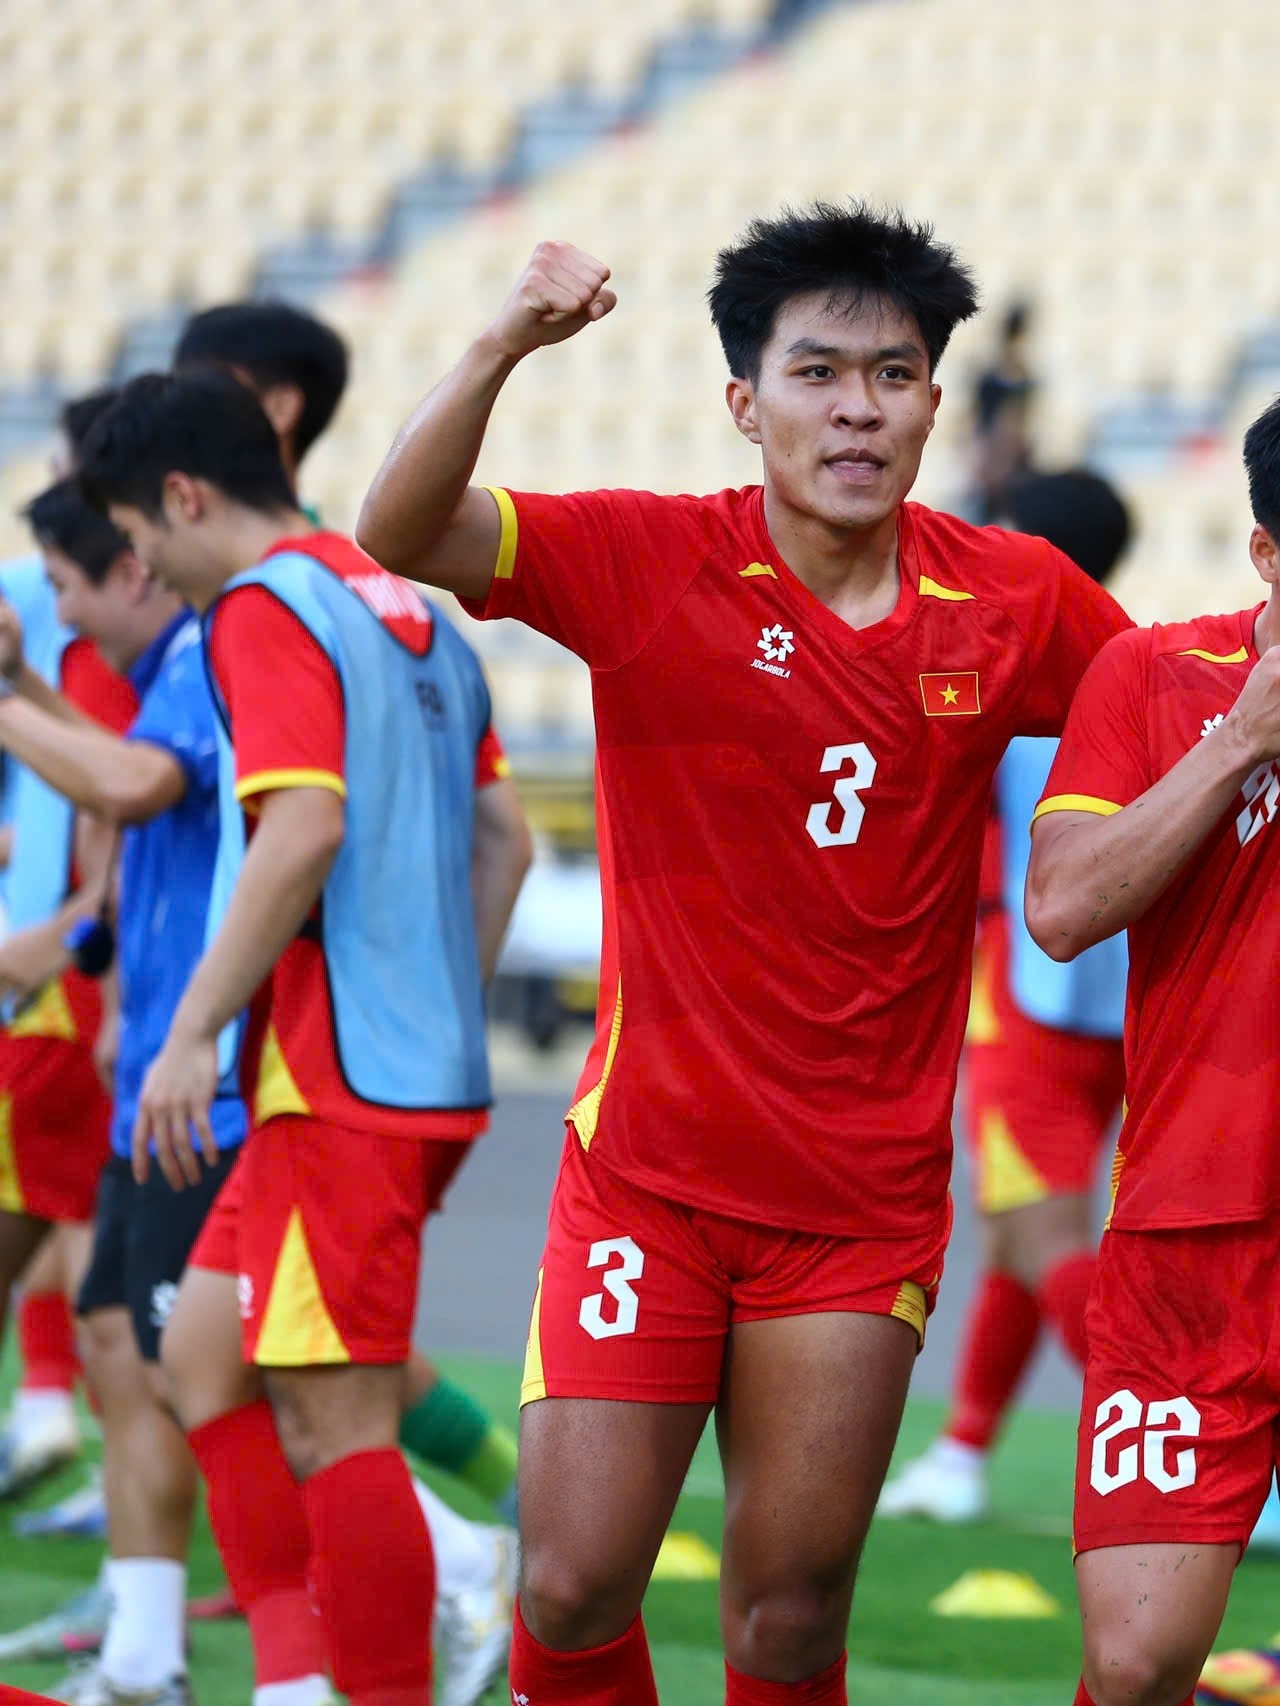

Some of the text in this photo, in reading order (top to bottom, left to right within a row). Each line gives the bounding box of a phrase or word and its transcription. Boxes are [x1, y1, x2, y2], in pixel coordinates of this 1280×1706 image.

[805, 741, 878, 849] 3
[579, 1235, 646, 1341] 3
[1089, 1388, 1202, 1497] 22
